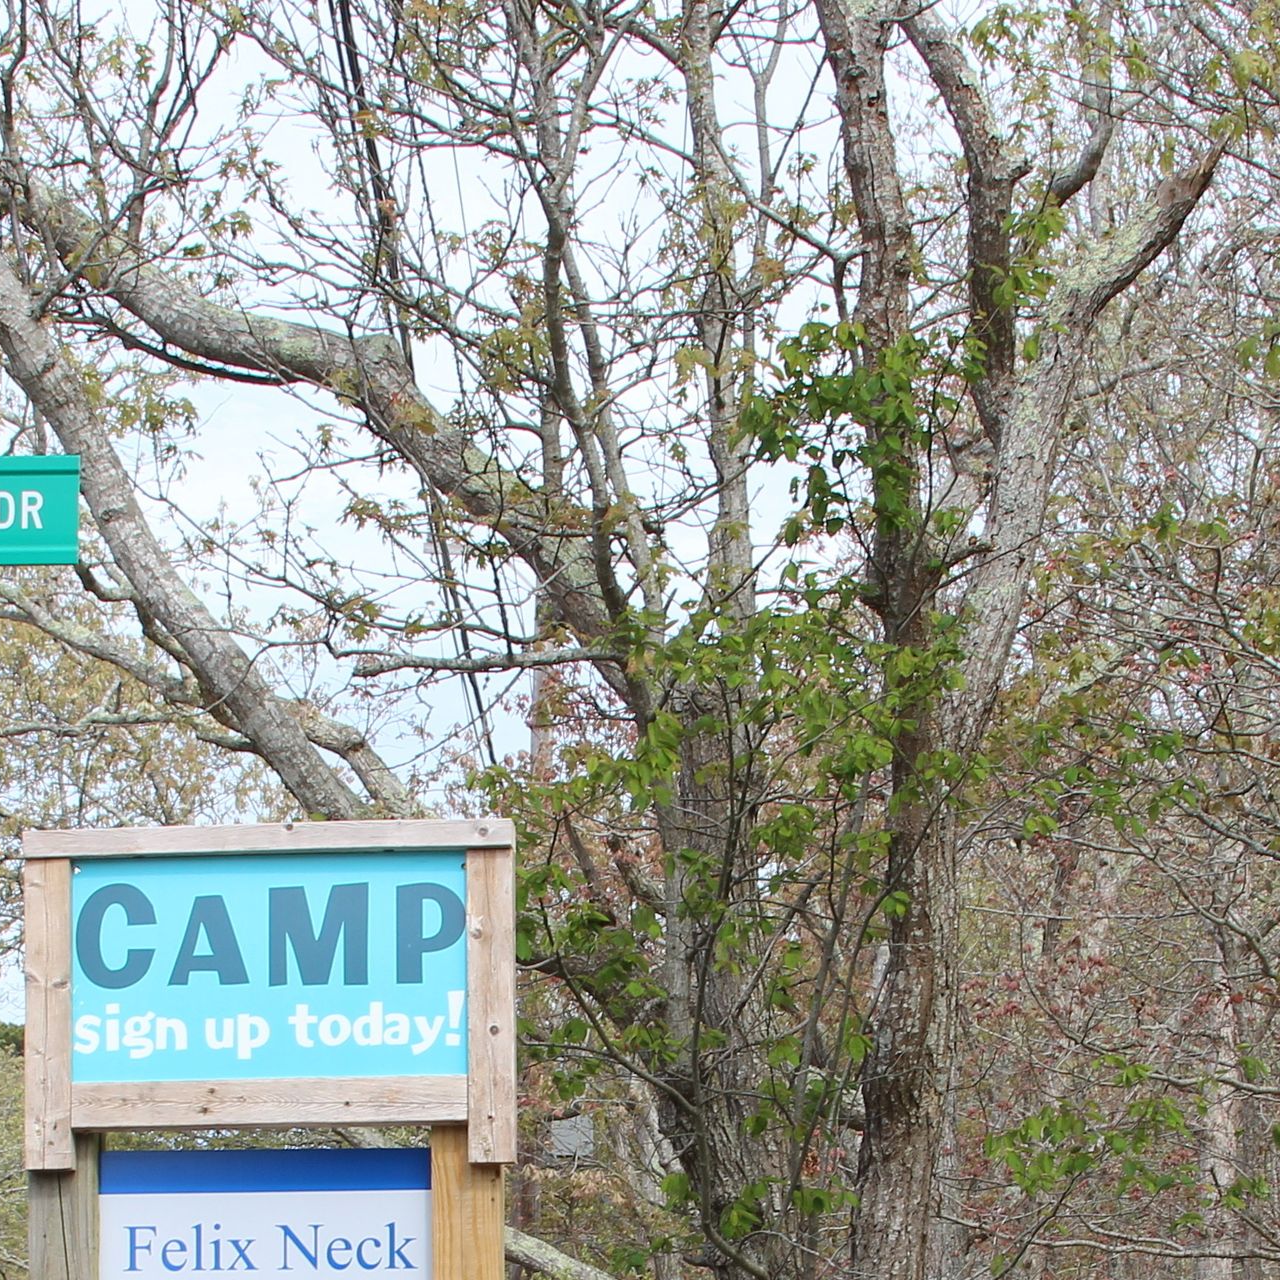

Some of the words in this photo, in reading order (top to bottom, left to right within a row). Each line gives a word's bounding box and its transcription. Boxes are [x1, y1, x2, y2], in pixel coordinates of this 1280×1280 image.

[75, 882, 466, 989] CAMP
[73, 1003, 188, 1059] sign
[205, 1013, 271, 1060] up
[288, 990, 465, 1056] today!
[122, 1223, 258, 1273] Felix
[276, 1222, 418, 1271] Neck
